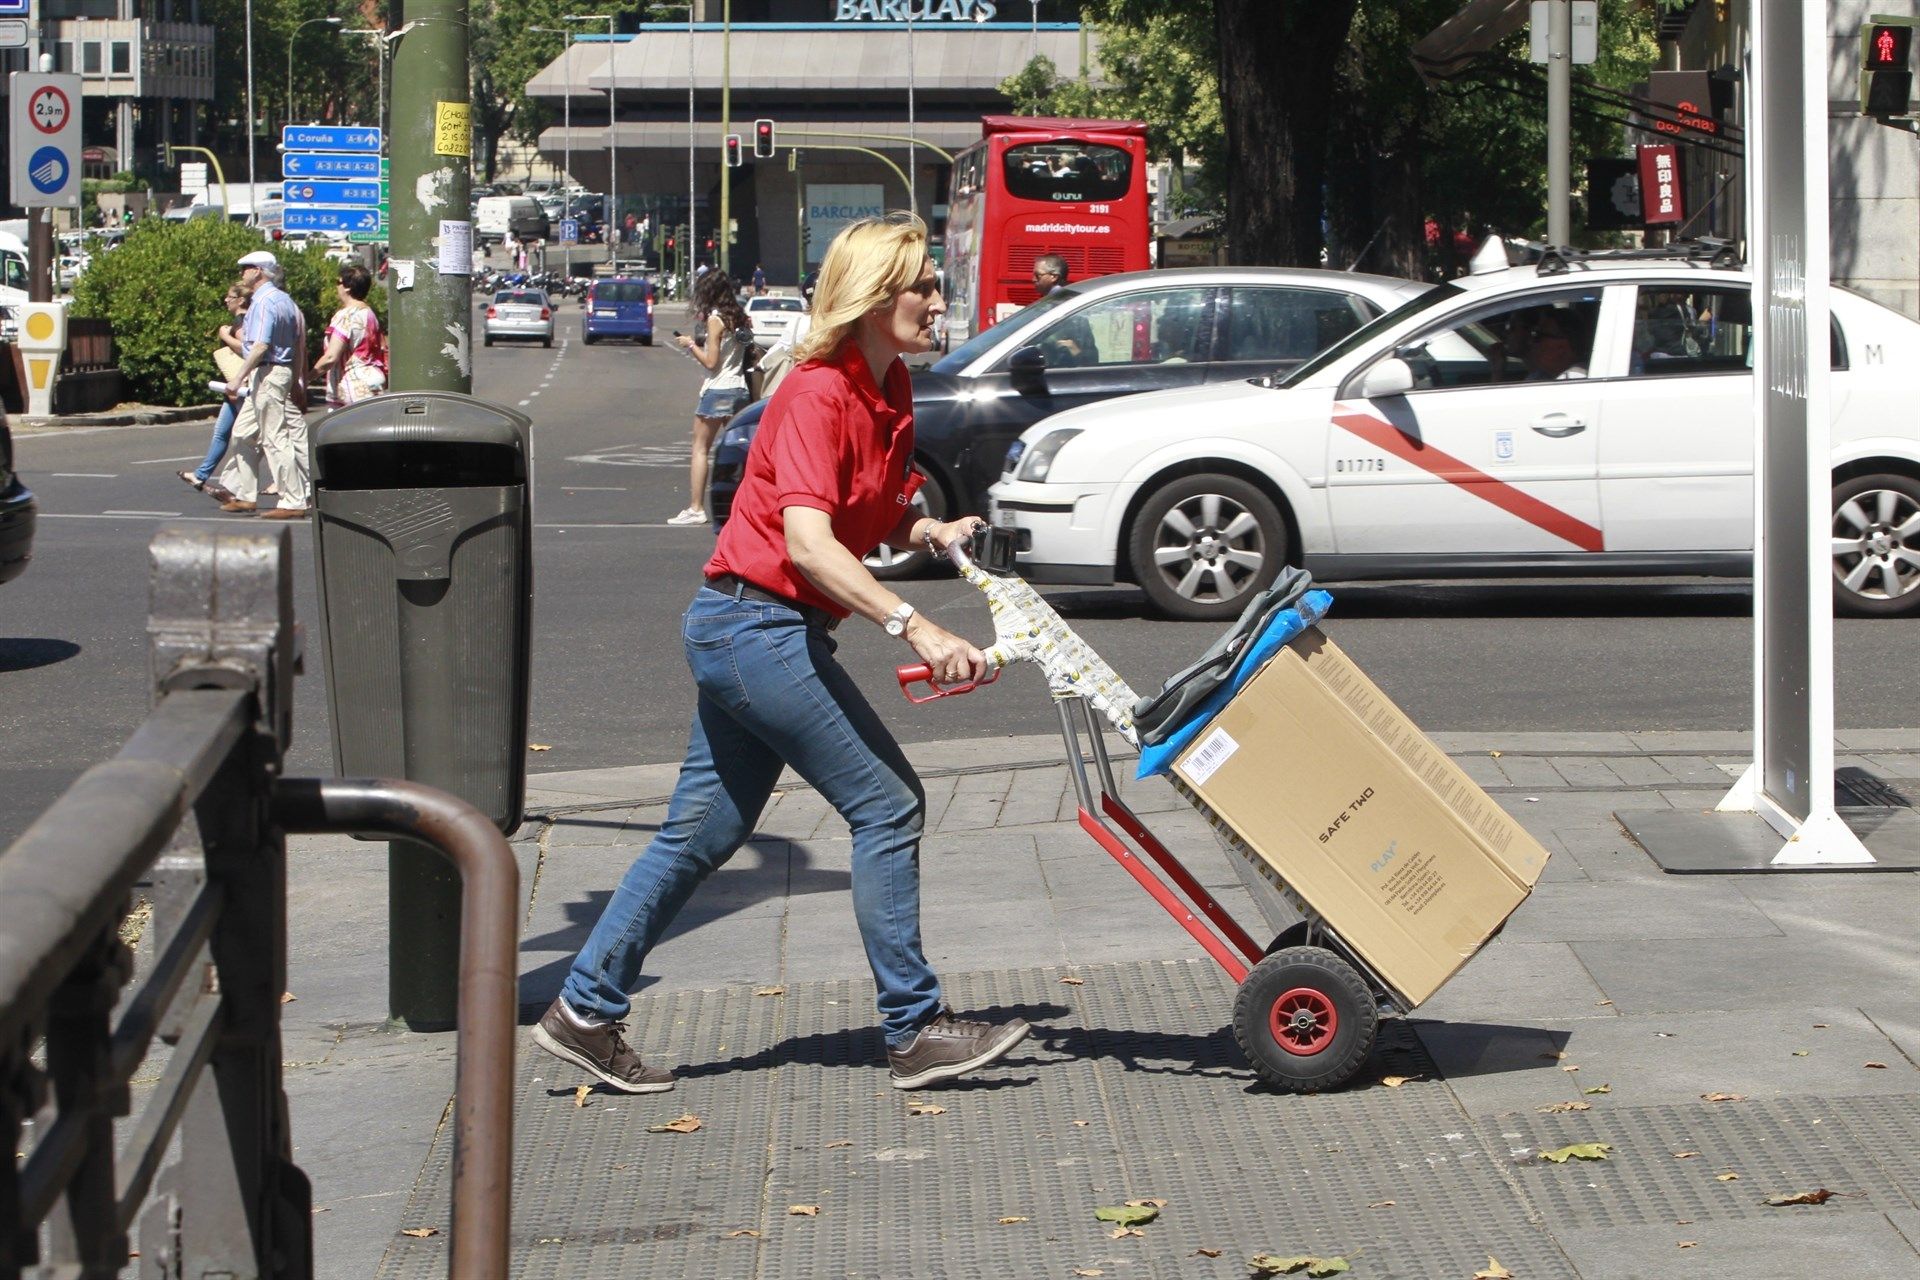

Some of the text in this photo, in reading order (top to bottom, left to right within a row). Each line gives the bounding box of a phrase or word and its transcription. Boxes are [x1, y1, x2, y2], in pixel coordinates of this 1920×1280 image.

[835, 0, 997, 21] BARCLAYS
[298, 134, 334, 142] Coruña
[1656, 154, 1673, 214] 無印良品
[811, 206, 881, 218] BARCLAYS
[1090, 204, 1109, 214] 3191
[1025, 224, 1110, 234] madridcitytour.es
[1865, 344, 1884, 364] M
[1336, 459, 1384, 472] 01779
[1318, 786, 1374, 843] SAFE TWO
